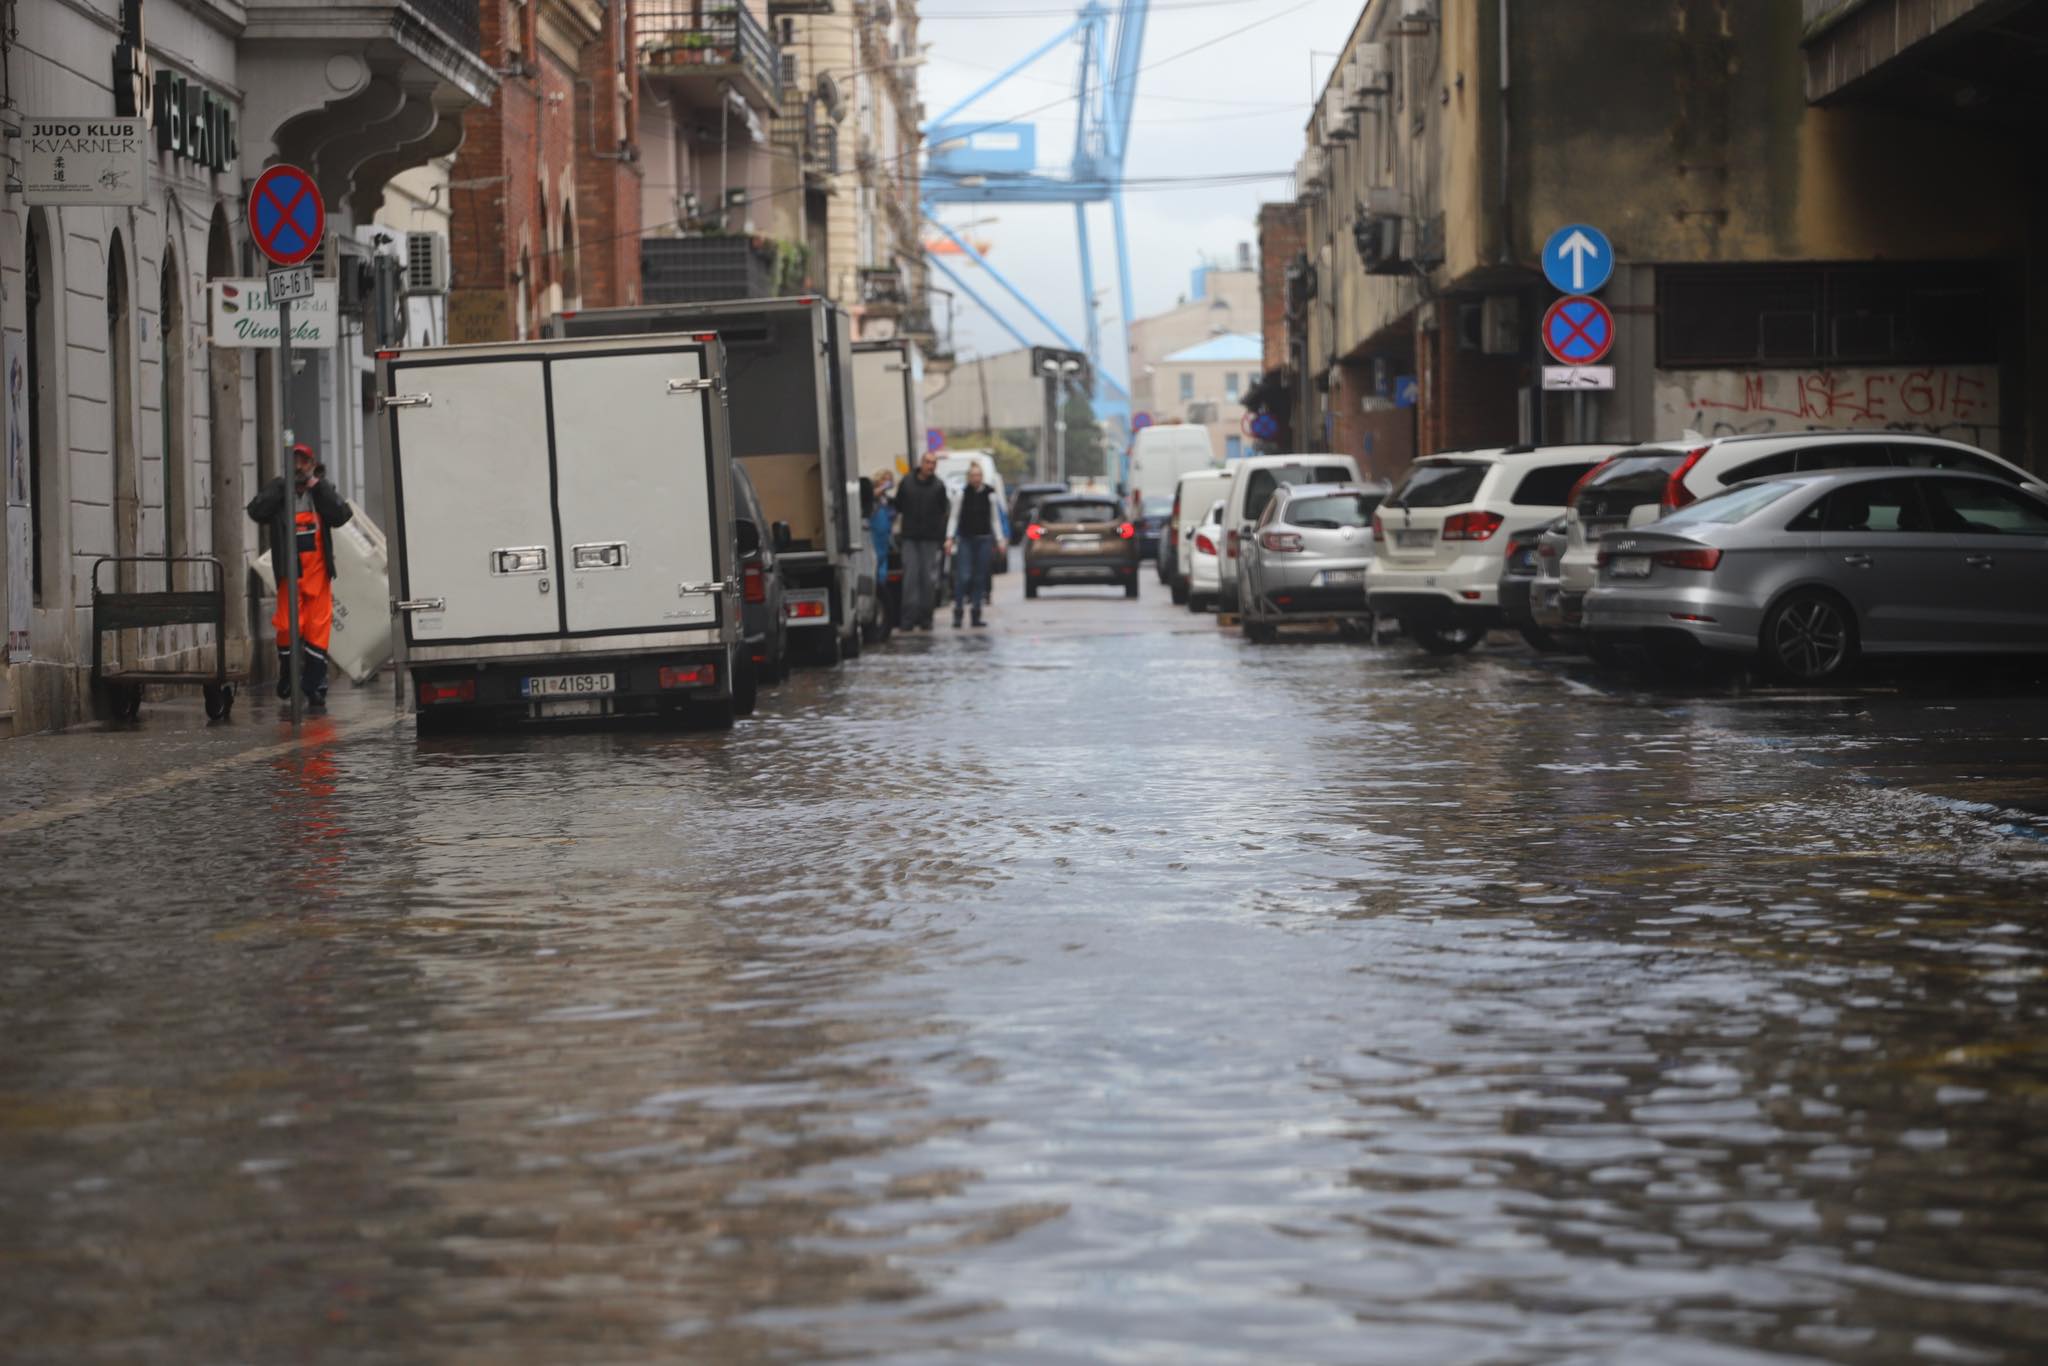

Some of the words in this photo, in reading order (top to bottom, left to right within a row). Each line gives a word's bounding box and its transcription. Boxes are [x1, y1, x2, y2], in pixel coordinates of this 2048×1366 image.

[32, 124, 80, 136] JUDO
[87, 124, 134, 136] KLUB
[25, 138, 142, 153] "KVARNER"
[273, 273, 300, 297] 06-16
[304, 271, 310, 290] h
[234, 318, 321, 340] Vinoeka
[531, 679, 547, 694] RI
